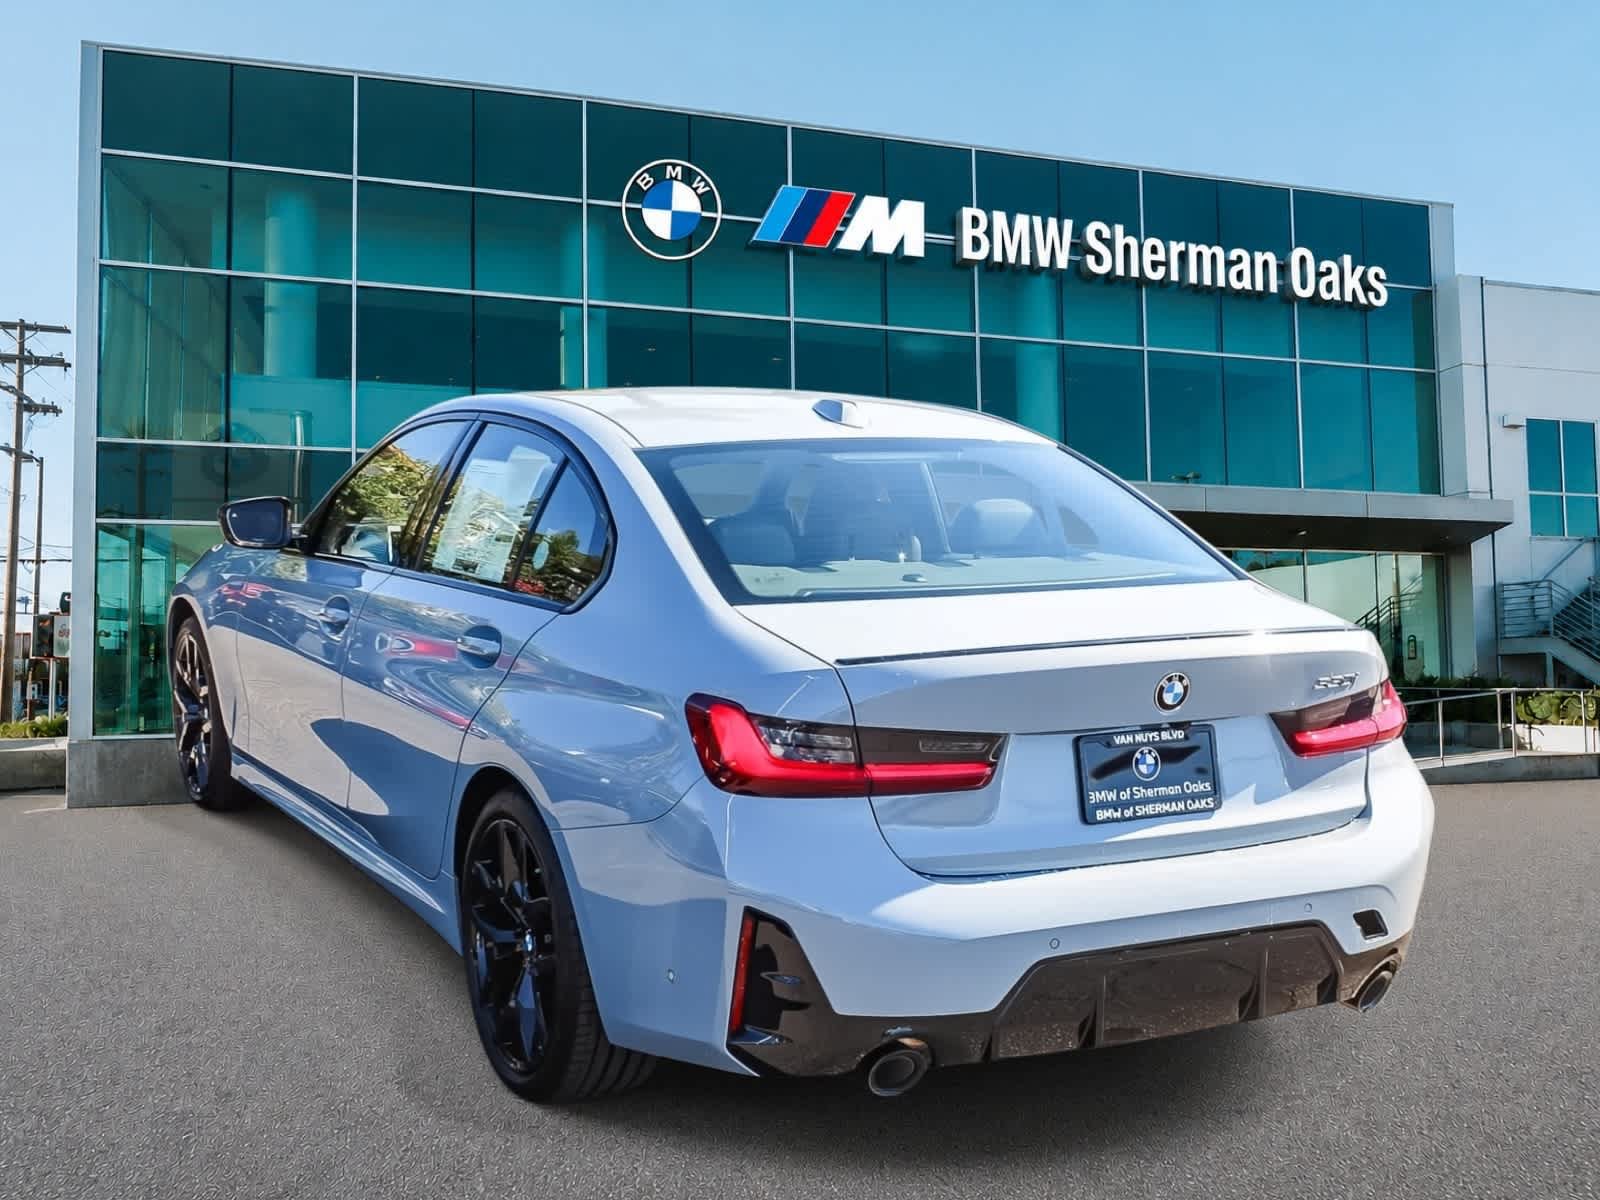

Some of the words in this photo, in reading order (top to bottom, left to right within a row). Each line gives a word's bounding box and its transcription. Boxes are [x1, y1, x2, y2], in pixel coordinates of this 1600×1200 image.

[636, 165, 711, 195] BMW
[835, 194, 925, 257] M
[959, 206, 1073, 270] BMW
[1083, 220, 1278, 294] Sherman
[1290, 246, 1389, 308] Oaks
[1113, 734, 1133, 745] VAN
[1135, 732, 1160, 743] NUYS
[1161, 729, 1185, 741] BLVD
[1119, 787, 1131, 801] of
[1132, 784, 1182, 799] Sherman
[1183, 780, 1212, 794] Oaks
[1096, 807, 1122, 821] BMW
[1123, 805, 1134, 818] of
[1135, 801, 1185, 816] SHERMAN
[1186, 797, 1214, 810] OAKS
